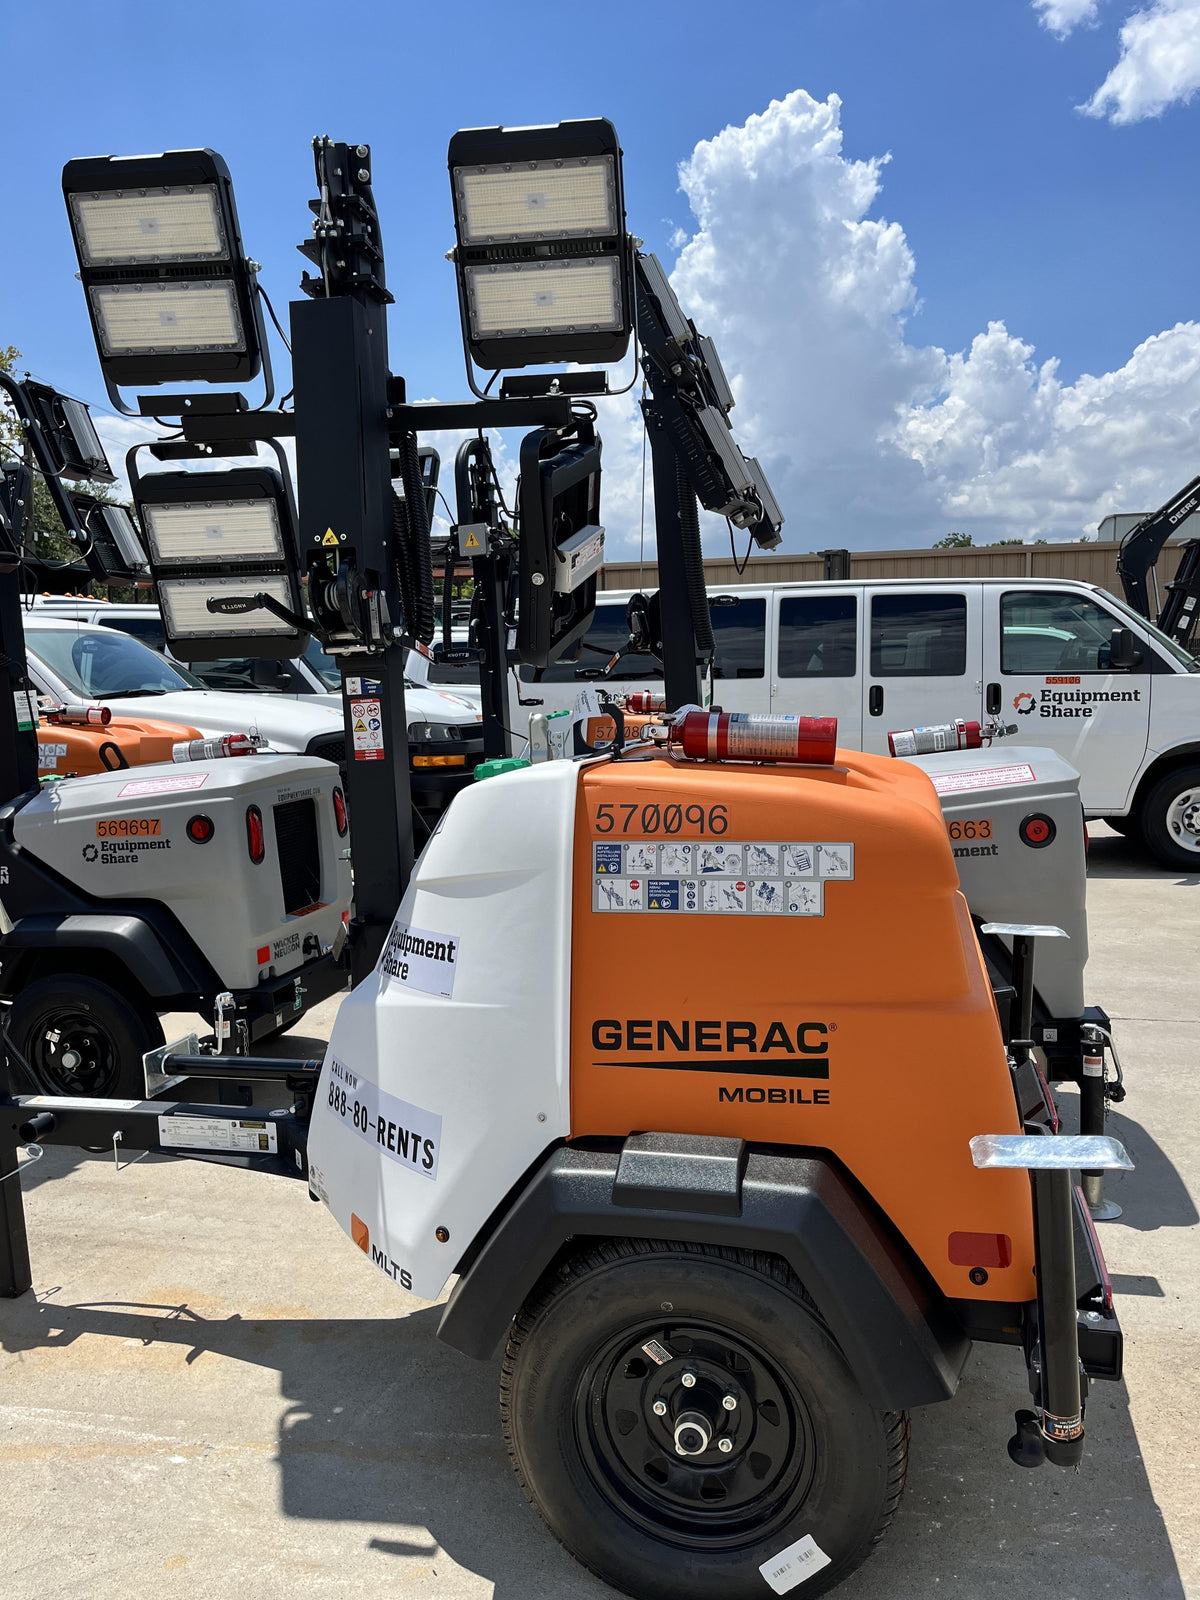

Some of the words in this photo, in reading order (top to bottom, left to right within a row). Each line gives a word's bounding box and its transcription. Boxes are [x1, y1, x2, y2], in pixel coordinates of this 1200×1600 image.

[1168, 498, 1198, 524] DEERE
[1040, 689, 1141, 704] Equipment
[1040, 705, 1092, 718] Share
[98, 819, 160, 836] 569697
[596, 804, 728, 835] 570096
[101, 839, 171, 853] Equipment
[101, 854, 138, 864] Share
[273, 933, 300, 950] WACKER
[274, 942, 300, 960] NEUSON
[332, 1060, 343, 1080] CALL
[345, 1071, 358, 1090] NOW
[718, 1087, 830, 1105] MOBILE
[328, 1081, 434, 1169] 888-80-RENTS
[372, 1244, 412, 1290] MLTS
